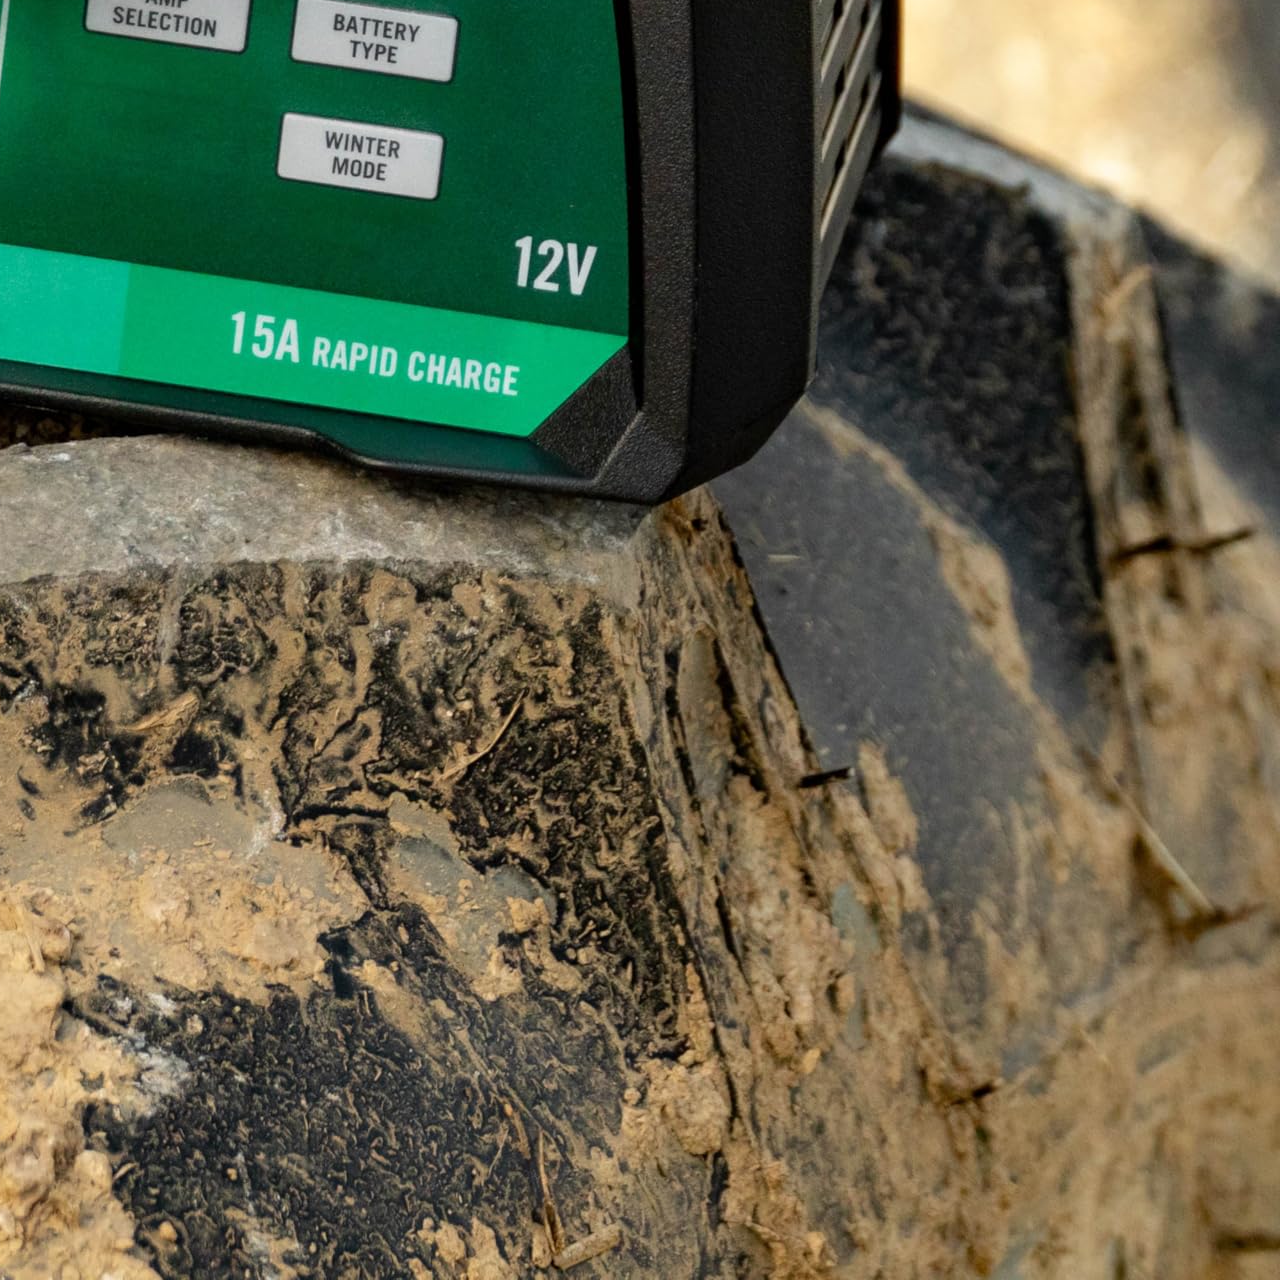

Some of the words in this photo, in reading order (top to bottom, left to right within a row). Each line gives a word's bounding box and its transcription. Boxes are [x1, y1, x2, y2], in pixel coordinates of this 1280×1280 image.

[112, 6, 218, 38] SELECTION
[333, 13, 420, 43] BATTERY
[349, 40, 398, 64] TYPE
[325, 131, 400, 159] WINTER
[331, 157, 387, 182] MODE
[515, 235, 598, 296] 12V
[231, 311, 301, 363] 15A
[312, 337, 398, 378] RAPID
[407, 352, 520, 397] CHARGE
